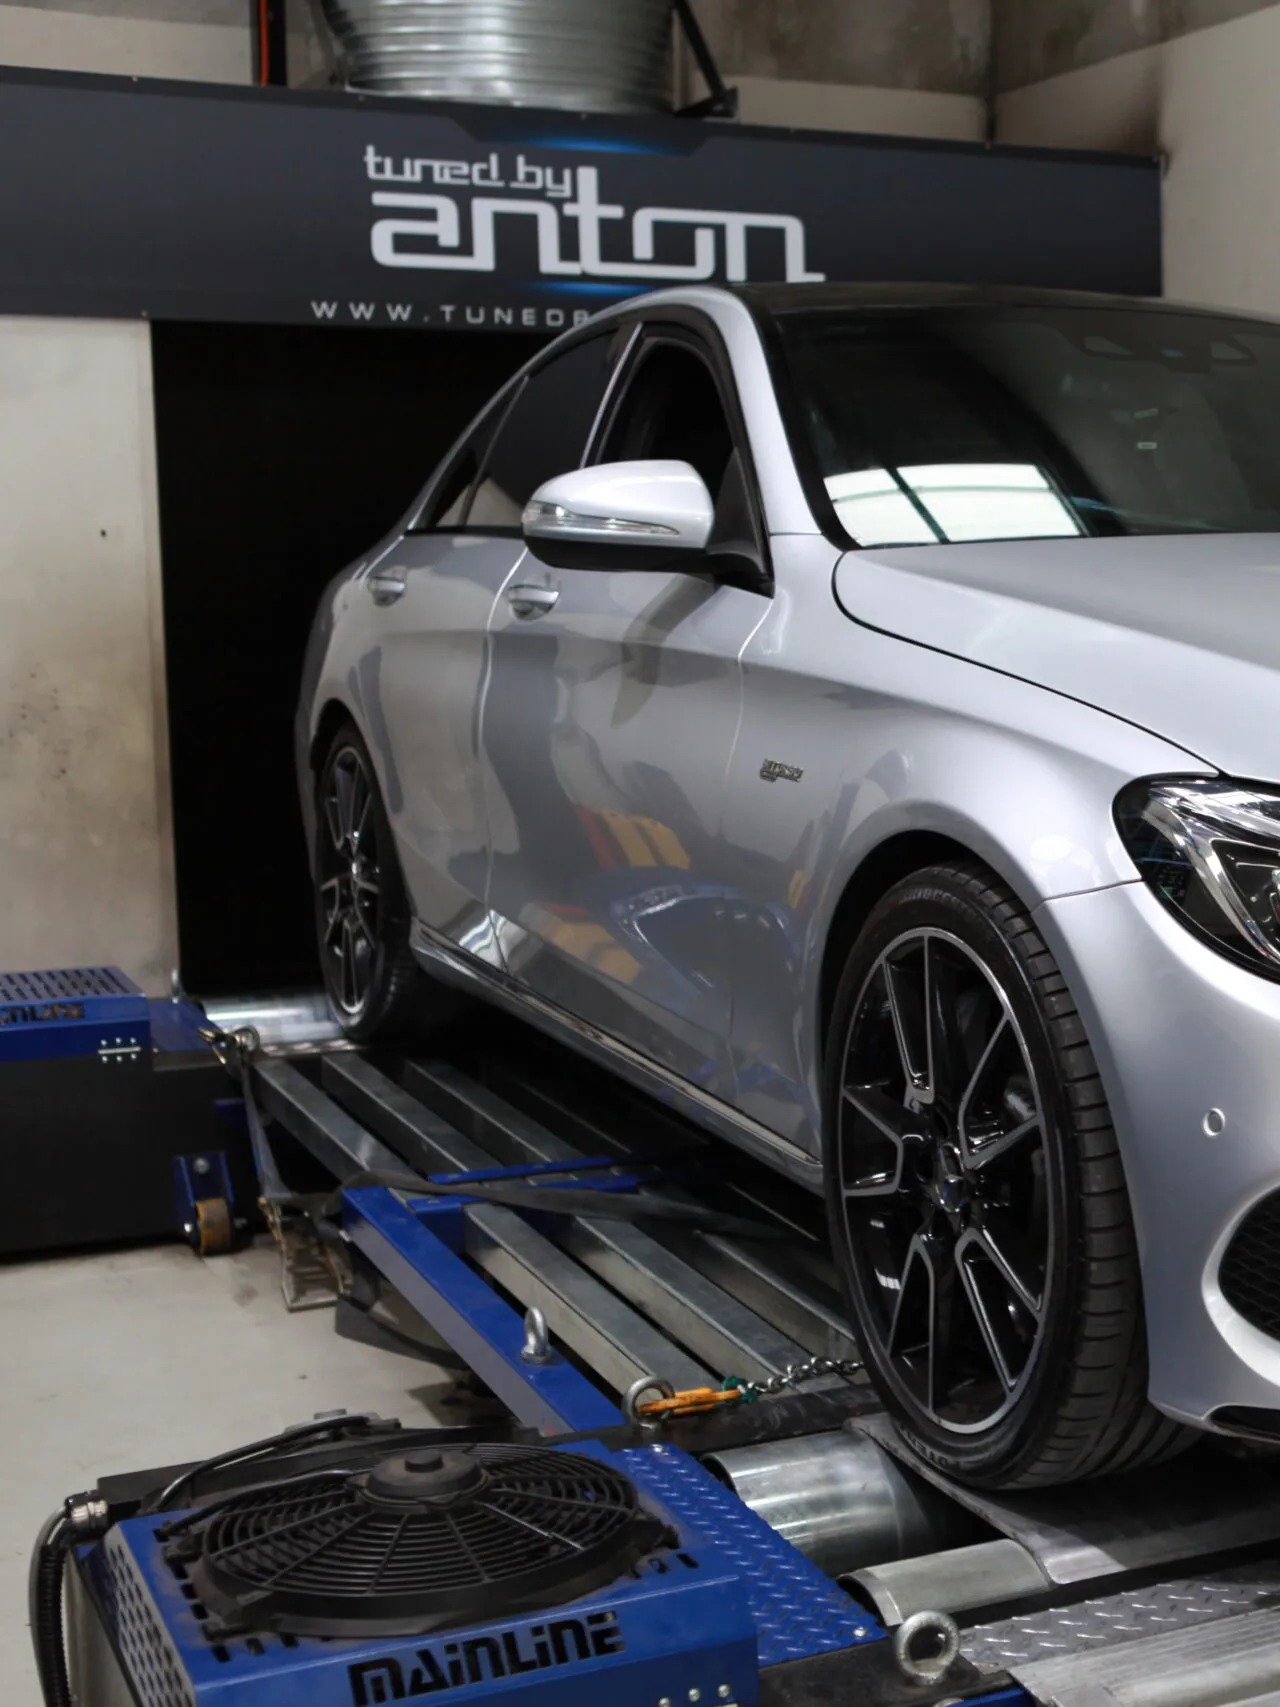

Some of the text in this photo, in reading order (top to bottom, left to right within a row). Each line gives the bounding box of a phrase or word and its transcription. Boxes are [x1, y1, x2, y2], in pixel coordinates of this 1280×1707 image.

[364, 145, 572, 198] tuned by
[371, 166, 826, 283] anton
[311, 302, 590, 327] WWW.TUNEDB
